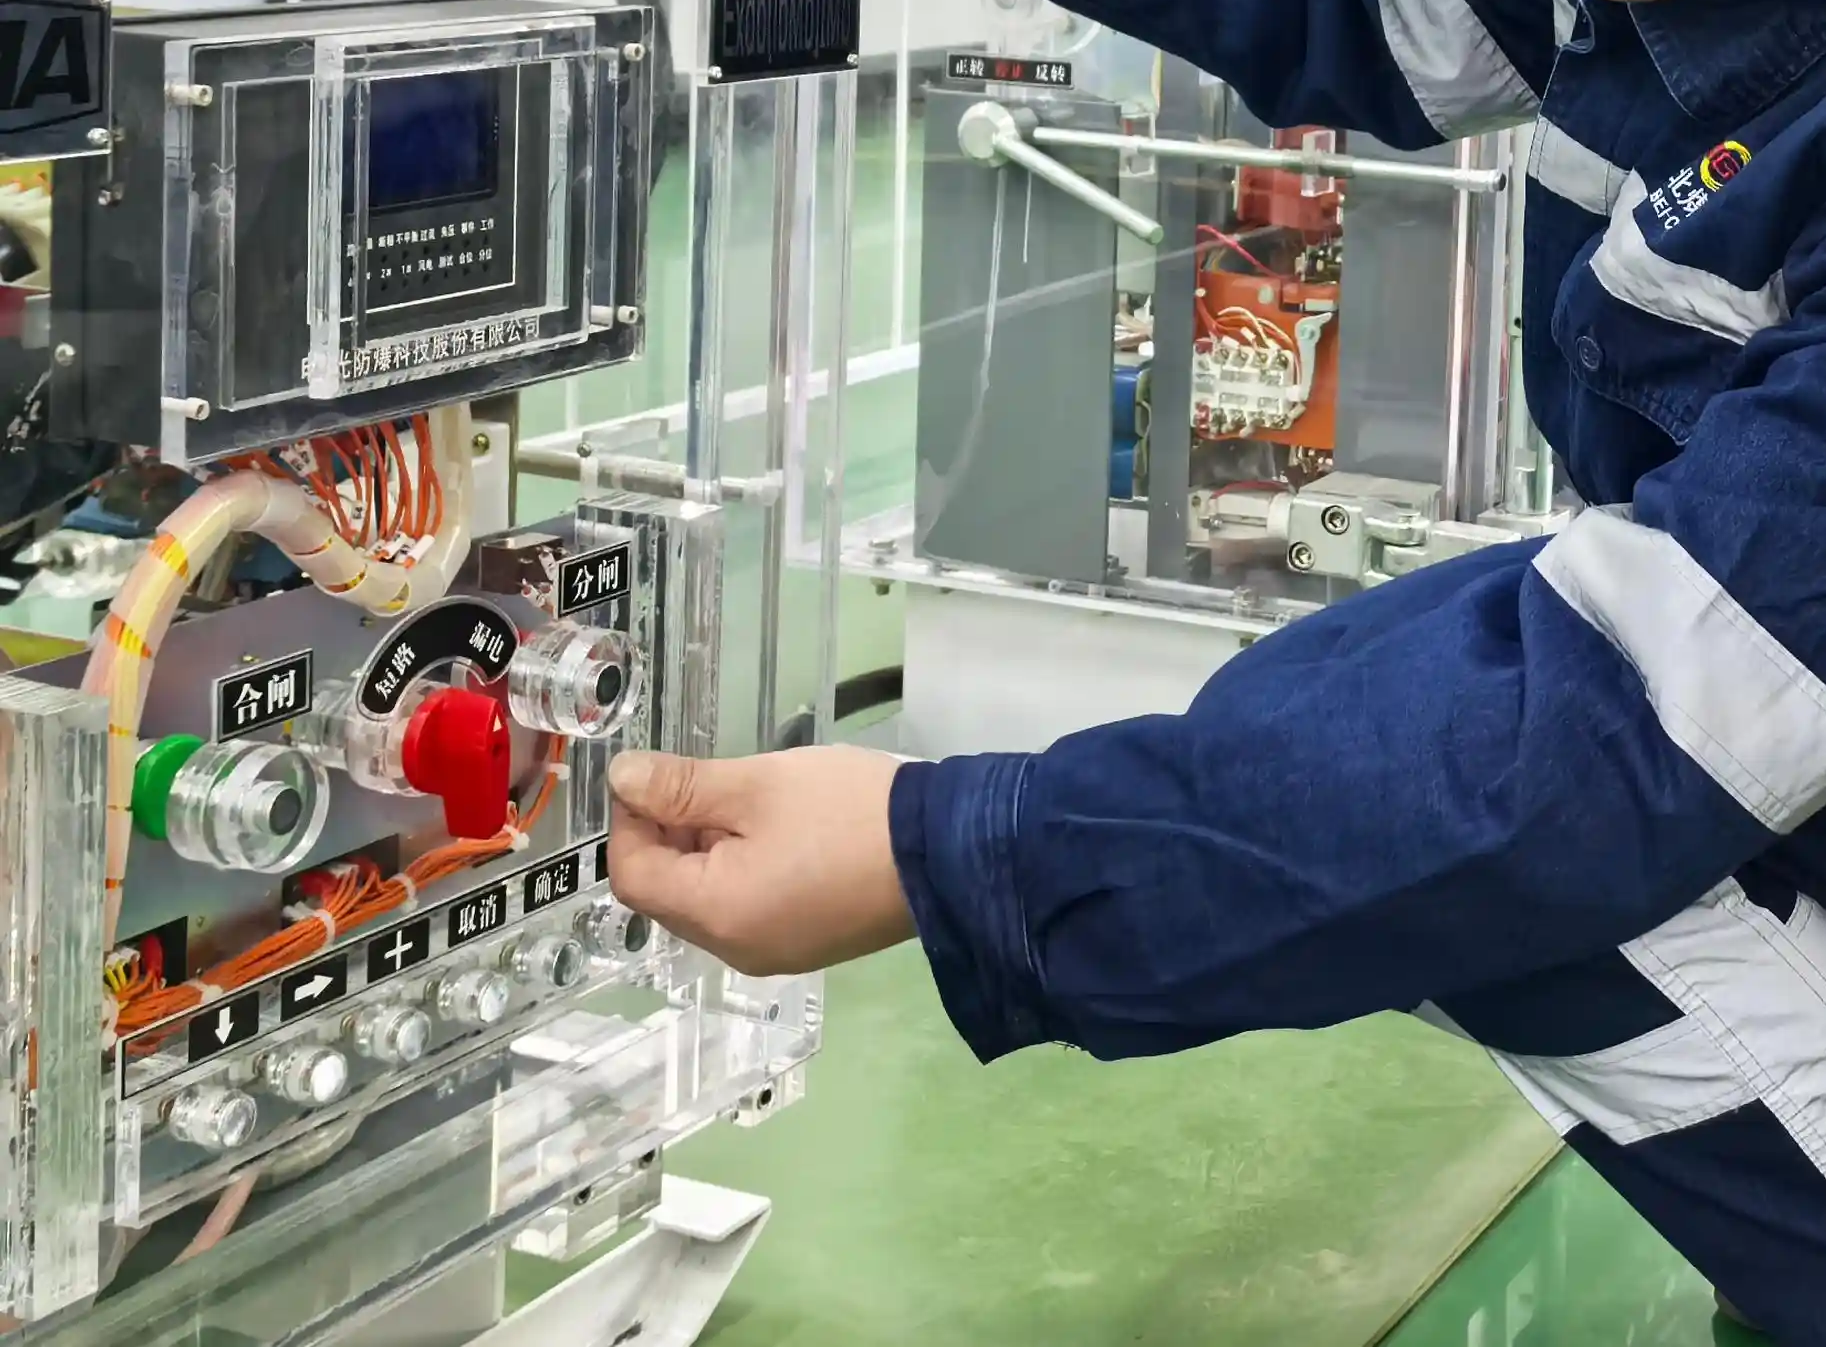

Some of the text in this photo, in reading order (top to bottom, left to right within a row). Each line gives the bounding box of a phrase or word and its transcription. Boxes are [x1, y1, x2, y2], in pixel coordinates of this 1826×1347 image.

[572, 555, 620, 603] 分闸
[233, 668, 296, 725] 合闸
[458, 893, 498, 937] 取消
[535, 863, 571, 903] 确定
